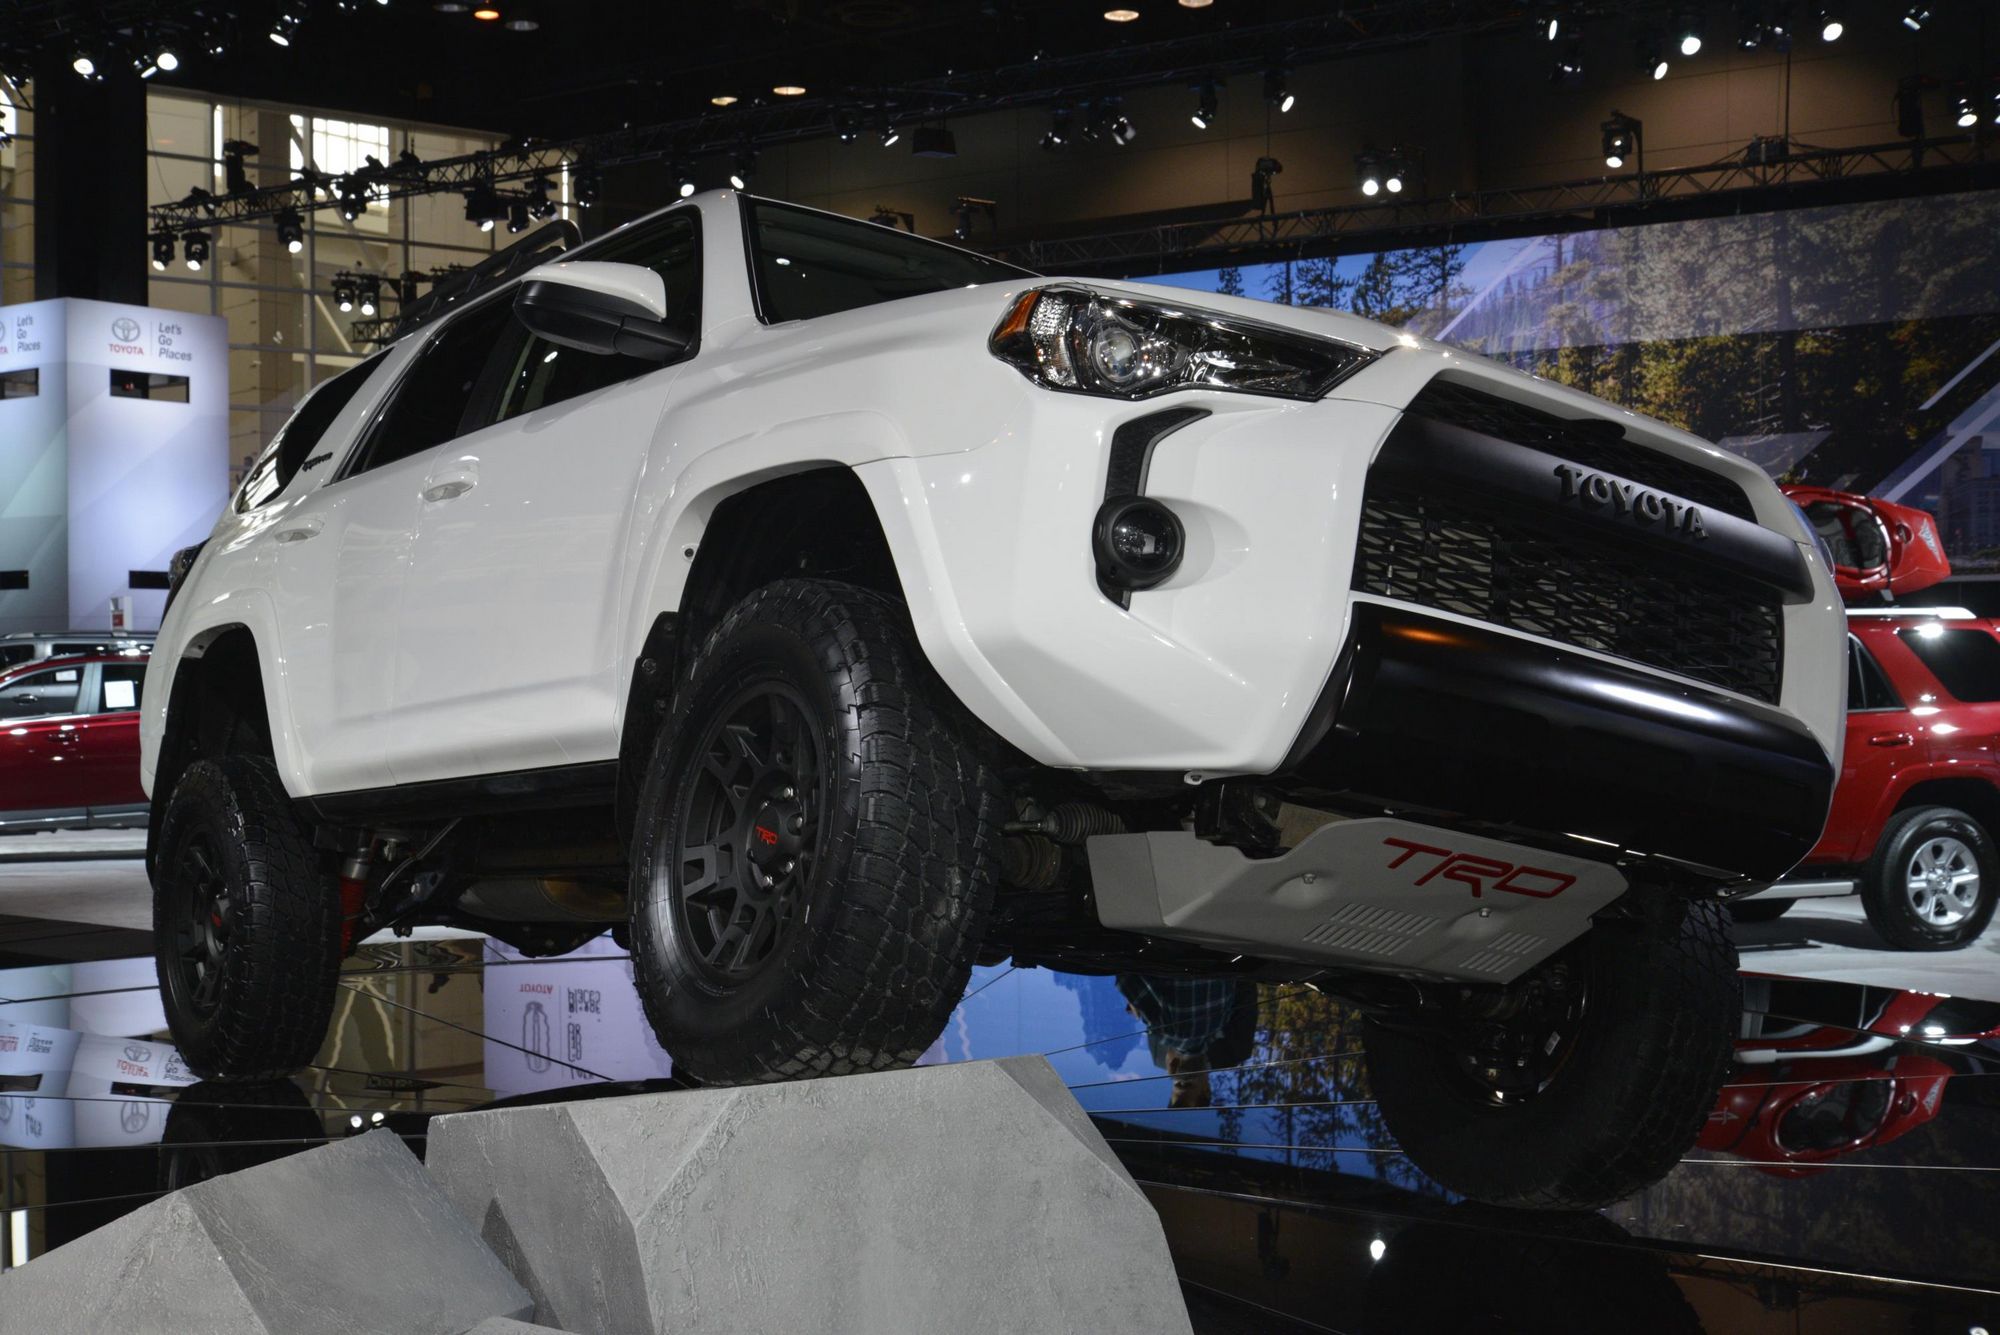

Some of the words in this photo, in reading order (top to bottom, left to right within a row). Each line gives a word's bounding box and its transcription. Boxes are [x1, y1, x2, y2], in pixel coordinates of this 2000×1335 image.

[17, 328, 27, 339] Go
[158, 322, 182, 335] Let's
[158, 334, 173, 346] Go
[108, 343, 144, 355] TOYOTA
[158, 347, 192, 361] Places
[1553, 464, 1709, 540] TOYOTA
[755, 825, 778, 845] TRD
[1382, 836, 1577, 899] TRD
